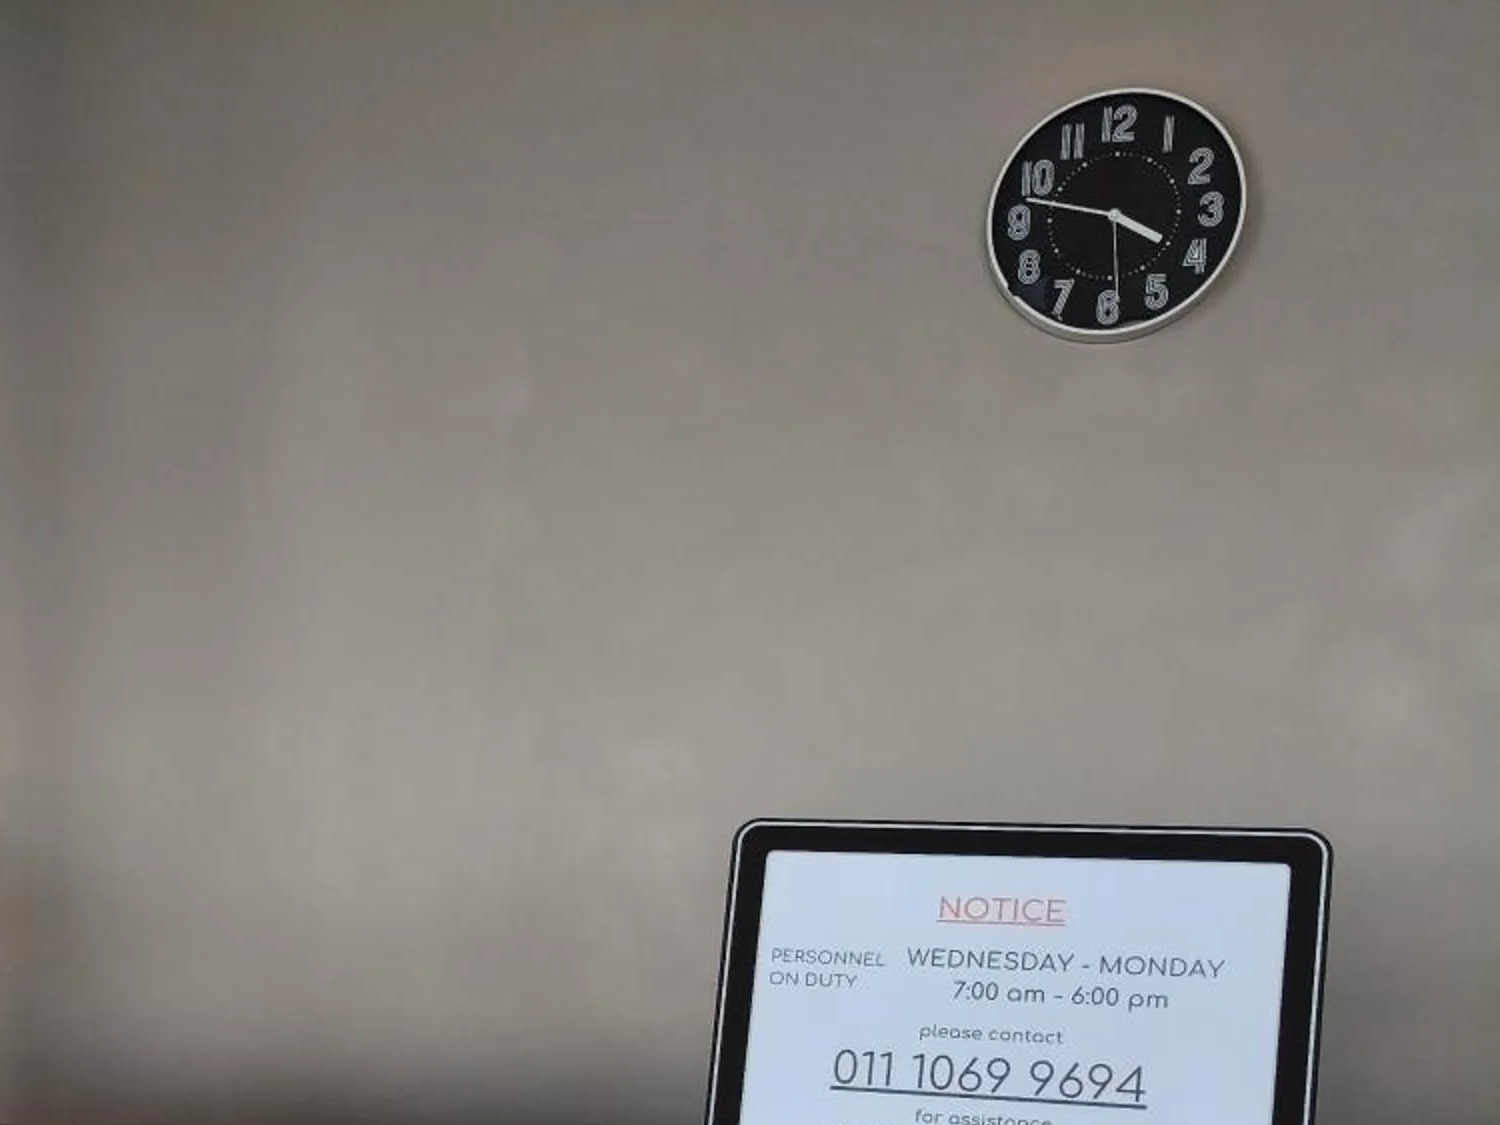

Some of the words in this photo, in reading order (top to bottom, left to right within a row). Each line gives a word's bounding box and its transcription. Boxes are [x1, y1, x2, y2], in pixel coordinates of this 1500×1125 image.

[1060, 122, 1085, 160] 11
[1101, 104, 1139, 143] 12
[1161, 115, 1175, 153] 1
[1021, 159, 1055, 197] 10
[1187, 147, 1215, 185] 2
[1007, 204, 1032, 241] 9
[1197, 191, 1225, 227] 3
[1017, 249, 1041, 285] 8
[1182, 237, 1208, 275] 4
[1051, 278, 1075, 321] 7
[1095, 289, 1120, 325] 6
[1144, 273, 1169, 310] 5
[937, 896, 1067, 924] NOTICE
[771, 948, 885, 967] PERSONNEL
[907, 948, 1075, 973] WEDNESDAY
[1099, 955, 1226, 979] MONDAY
[769, 971, 799, 986] ON
[805, 972, 858, 988] DUTY
[953, 980, 999, 1001] 7:00
[1007, 987, 1045, 1004] am
[1071, 986, 1119, 1006] 6:00
[1128, 992, 1169, 1012] pm
[919, 1024, 982, 1041] please
[988, 1029, 1064, 1045] contact
[834, 1049, 894, 1087] 011
[912, 1053, 1011, 1093] 1069
[1030, 1060, 1147, 1102] 9694
[915, 1109, 942, 1124] for
